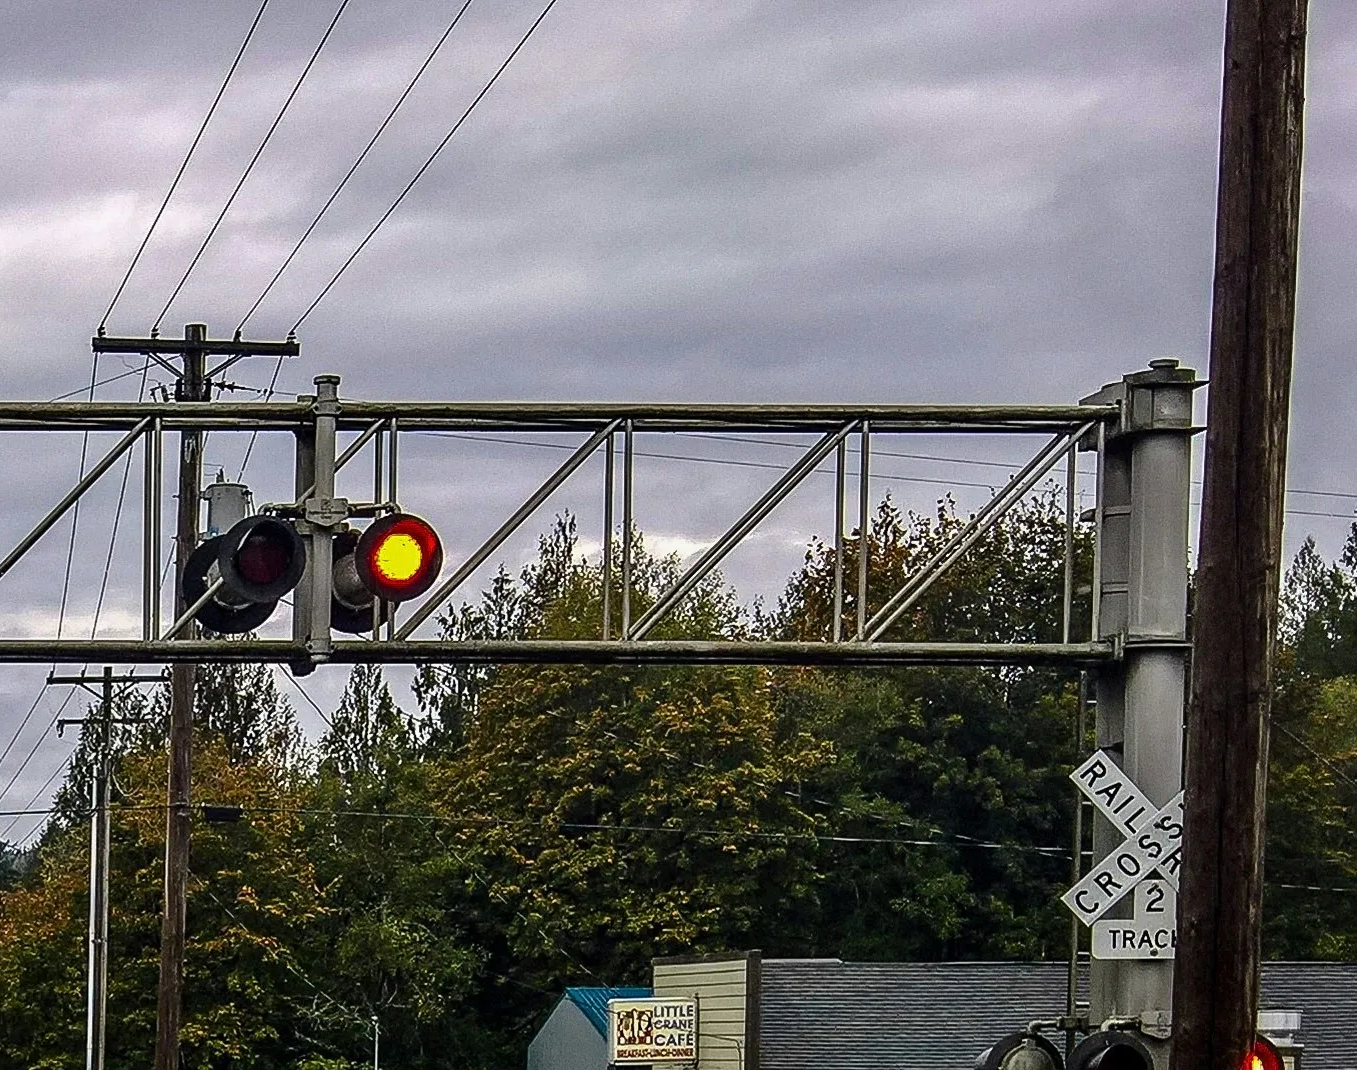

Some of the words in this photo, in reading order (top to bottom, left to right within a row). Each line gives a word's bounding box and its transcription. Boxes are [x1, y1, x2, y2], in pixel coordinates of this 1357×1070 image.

[1146, 882, 1164, 912] 2
[654, 1005, 694, 1017] LITTLE
[654, 1019, 694, 1029] CRANE
